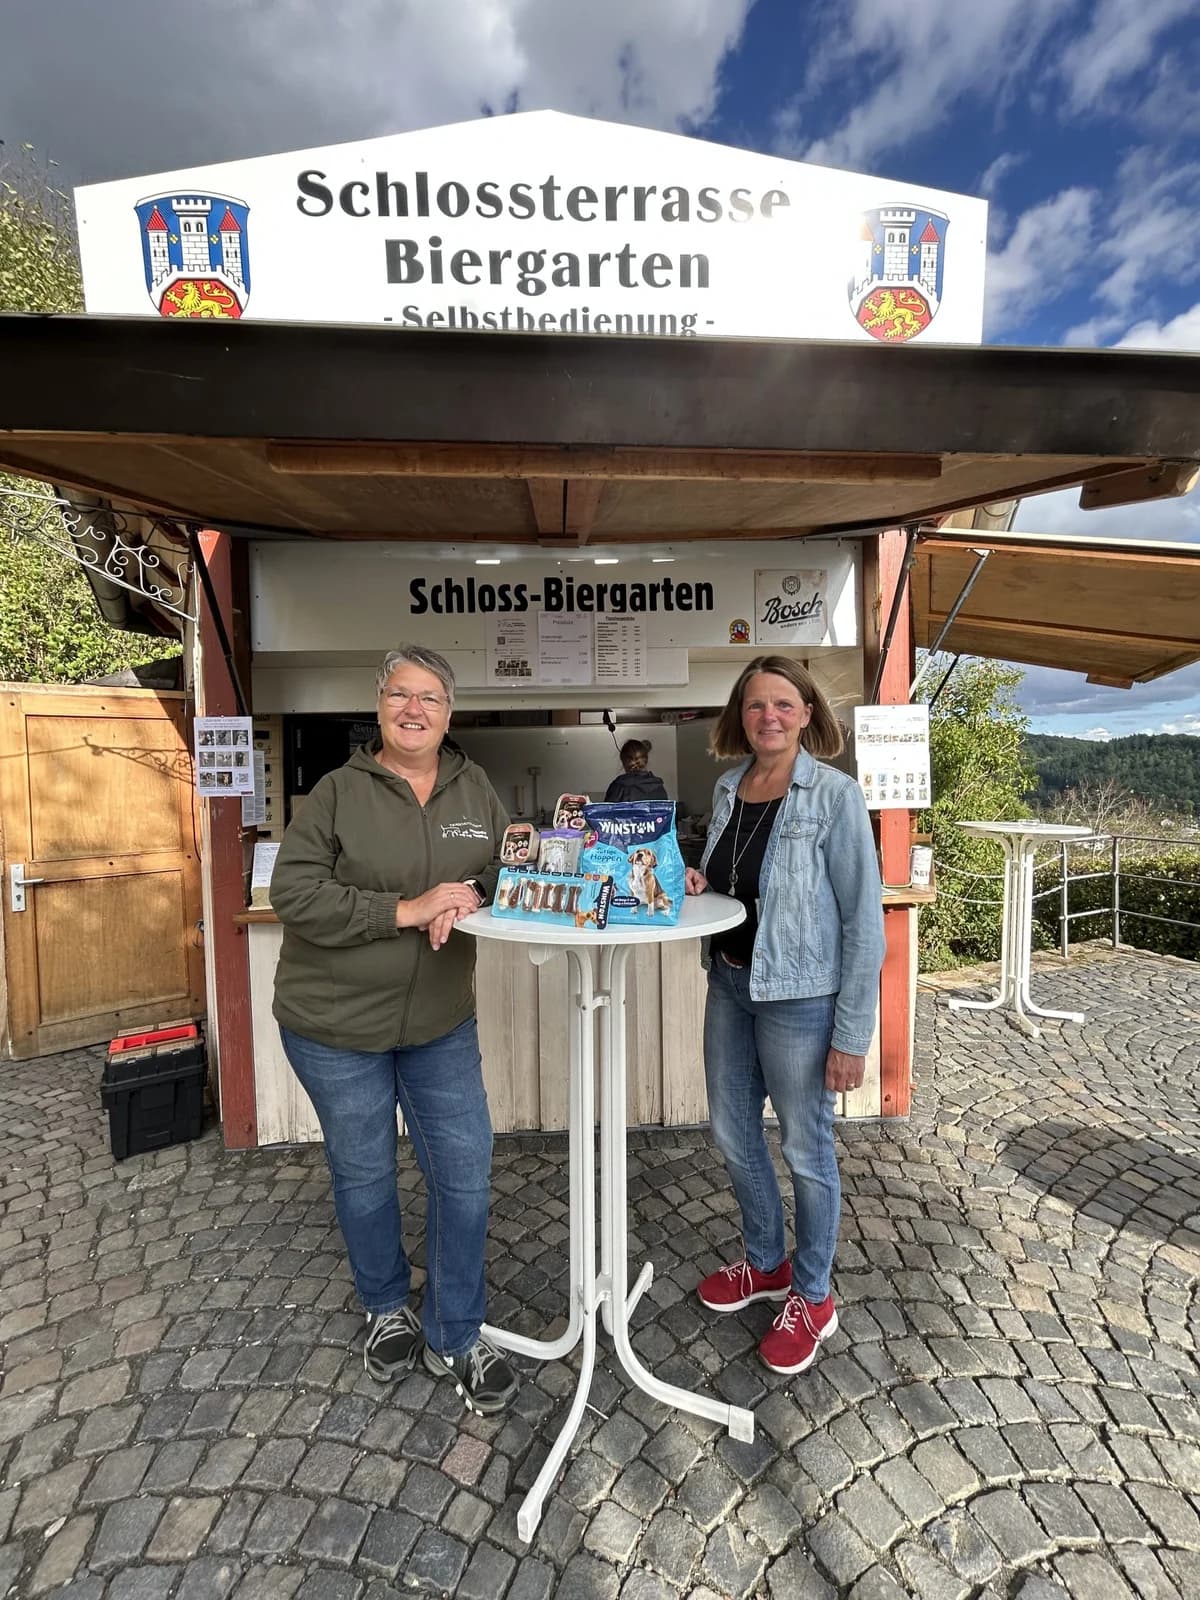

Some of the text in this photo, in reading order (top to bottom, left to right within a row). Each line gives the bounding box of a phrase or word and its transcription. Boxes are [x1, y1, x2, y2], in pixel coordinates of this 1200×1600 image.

[297, 170, 790, 223] Schlossterrasse
[385, 236, 709, 296] Biergarten
[410, 577, 714, 614] Schloss-Biergarten
[761, 592, 823, 625] Bosch
